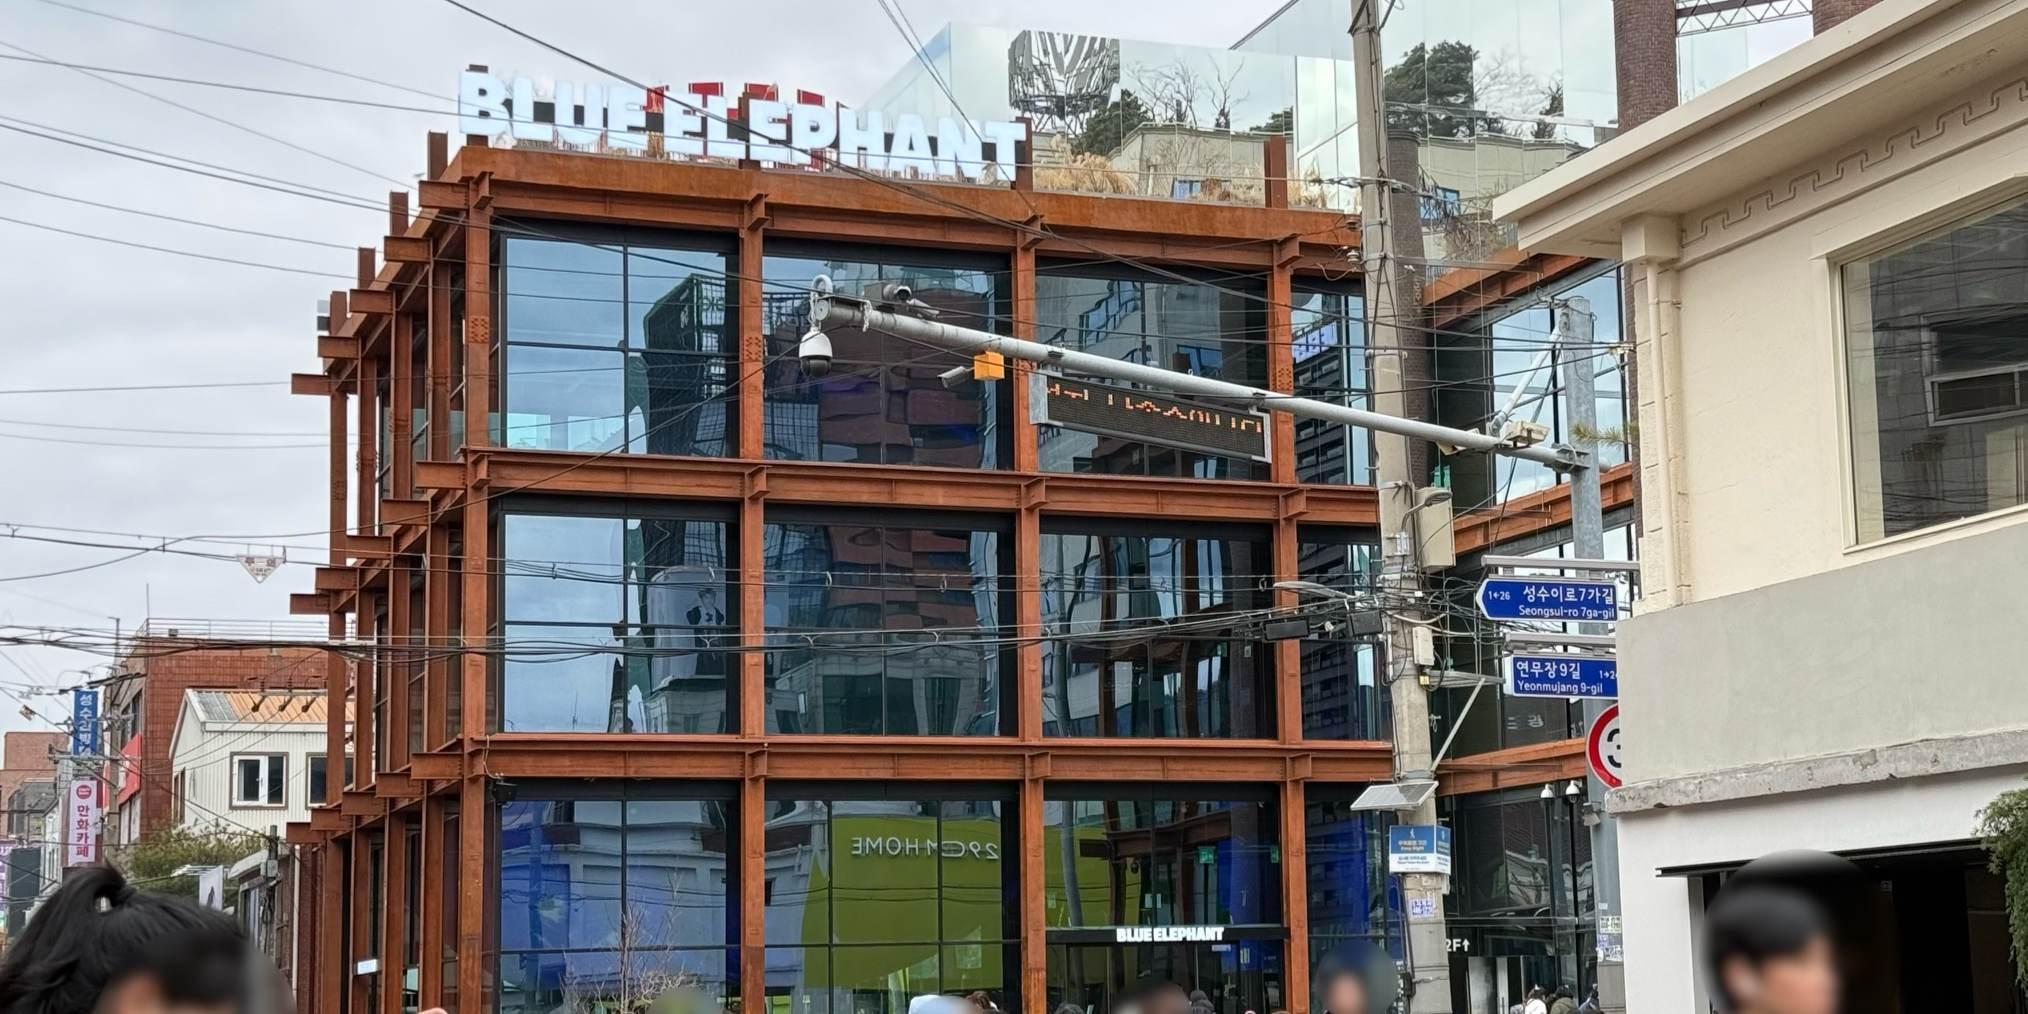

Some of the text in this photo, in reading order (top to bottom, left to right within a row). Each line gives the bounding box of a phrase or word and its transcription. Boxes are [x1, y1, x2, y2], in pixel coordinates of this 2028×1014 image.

[459, 71, 1027, 181] BLUE ELEPHANT
[1522, 585, 1614, 605] 성수이로7가길
[1518, 605, 1615, 619] Seongsui-ro 7ga-gil
[1516, 660, 1581, 680] 연무장9길
[1517, 680, 1604, 696] Yeonmujang 9-gil
[76, 805, 90, 858] 만화카페
[1116, 926, 1225, 943] BLUE ELEPHANT
[1446, 938, 1462, 952] 2F
